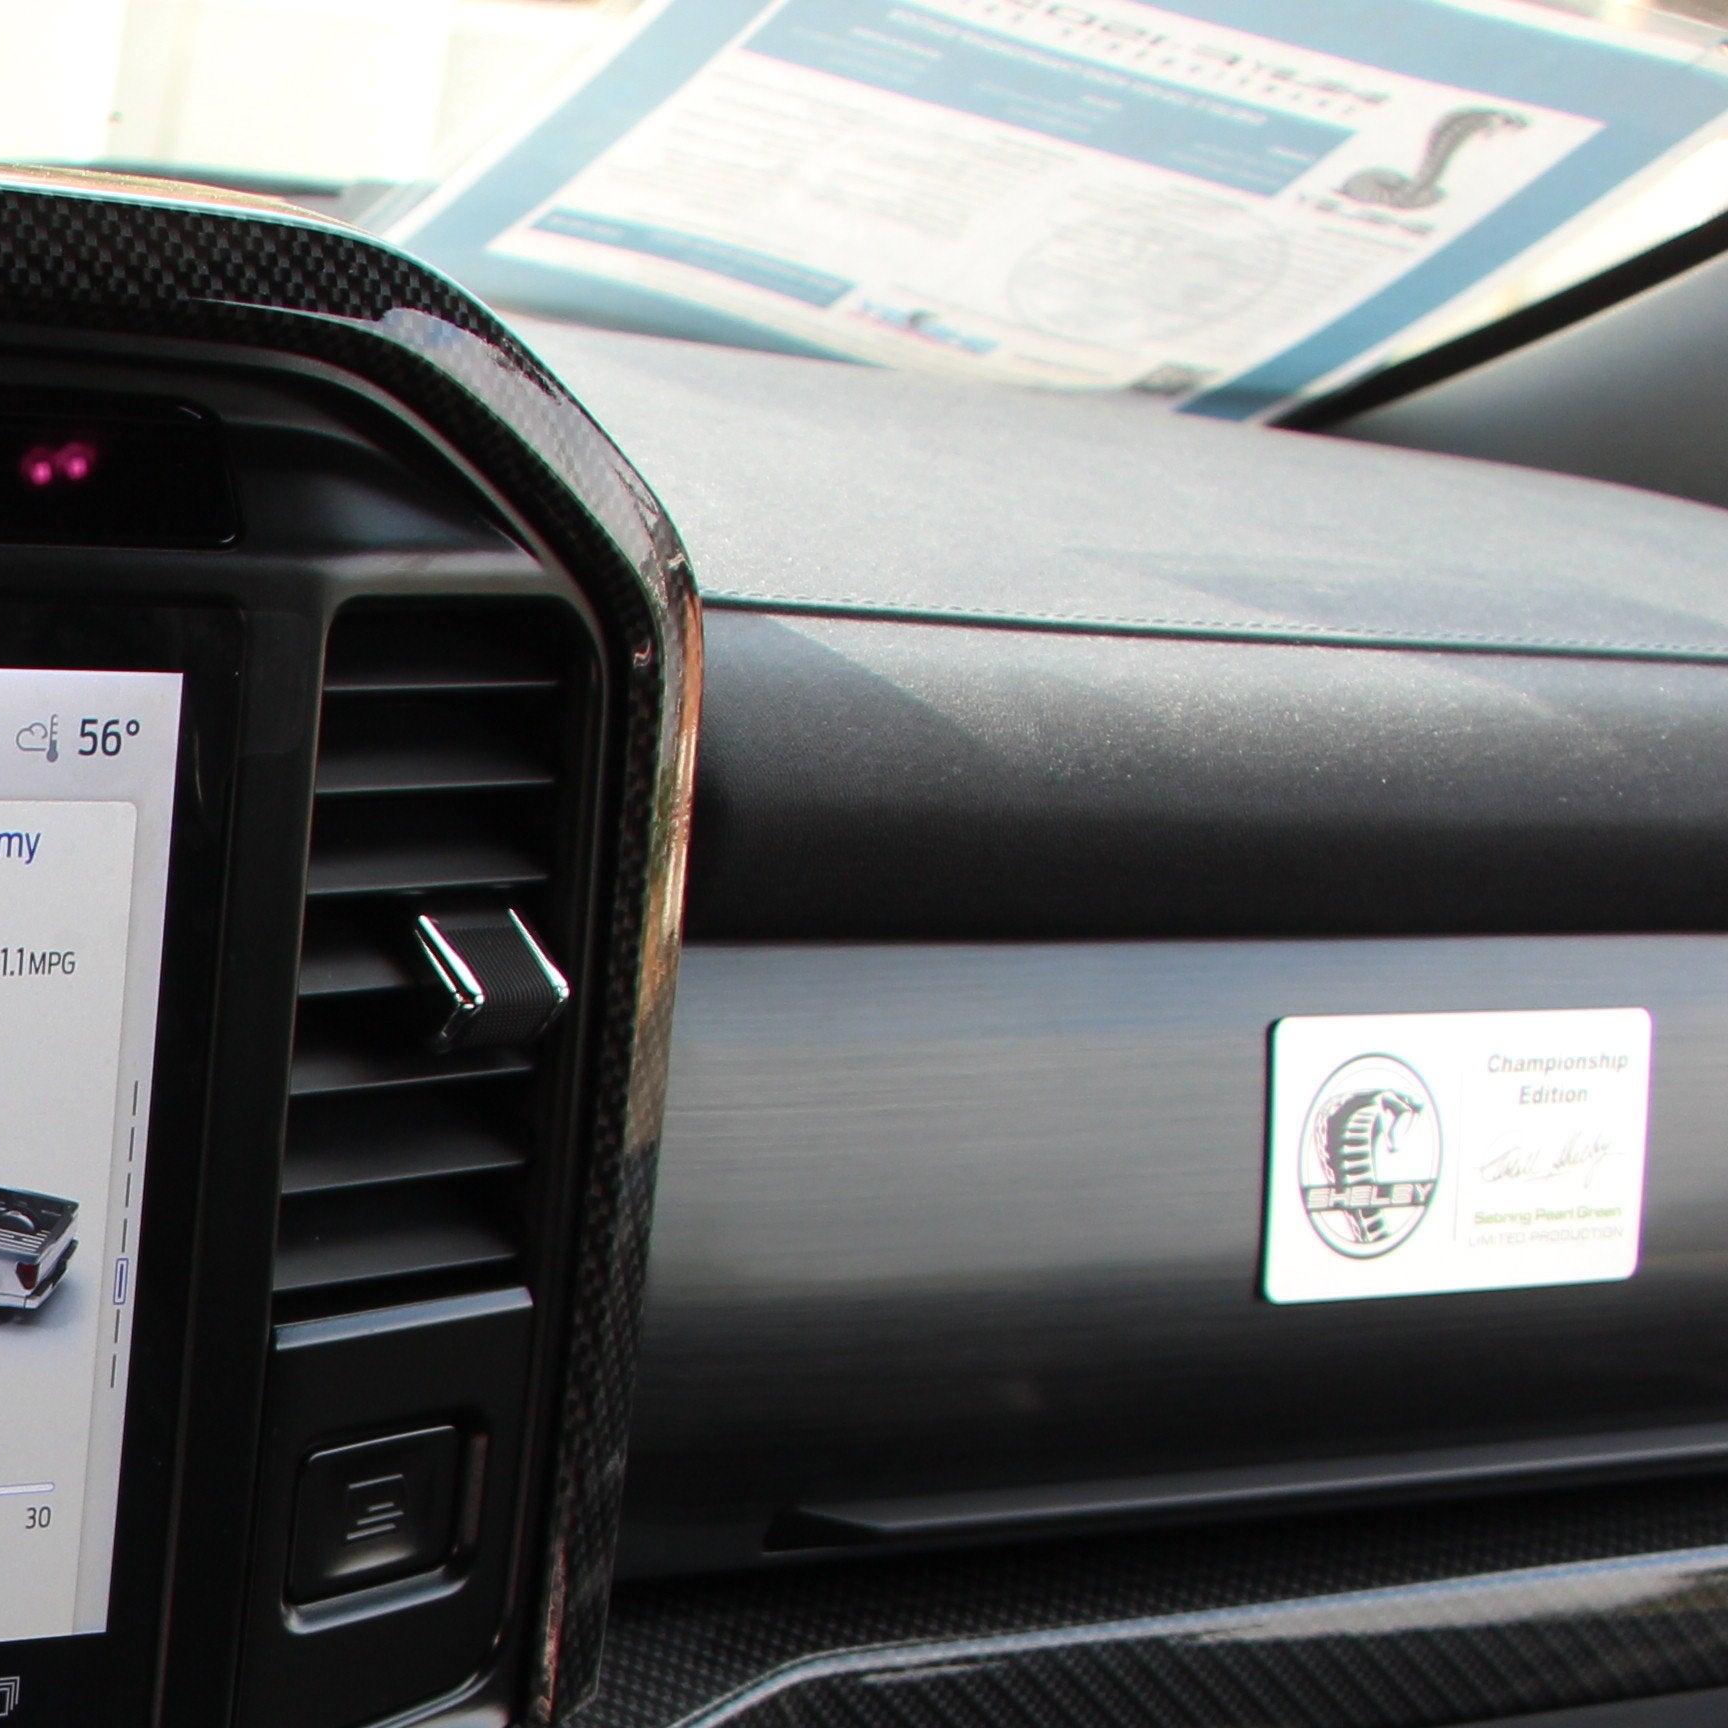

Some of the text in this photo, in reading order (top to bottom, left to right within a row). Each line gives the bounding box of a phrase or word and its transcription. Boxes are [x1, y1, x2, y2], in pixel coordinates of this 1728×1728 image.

[77, 716, 140, 757] 56°
[1487, 1053, 1629, 1075] Championship
[1519, 1085, 1588, 1105] Edition
[1307, 1181, 1434, 1209] SHELBY
[1468, 1226, 1623, 1248] LIMITED PRODUCTION
[25, 1506, 51, 1529] 30
